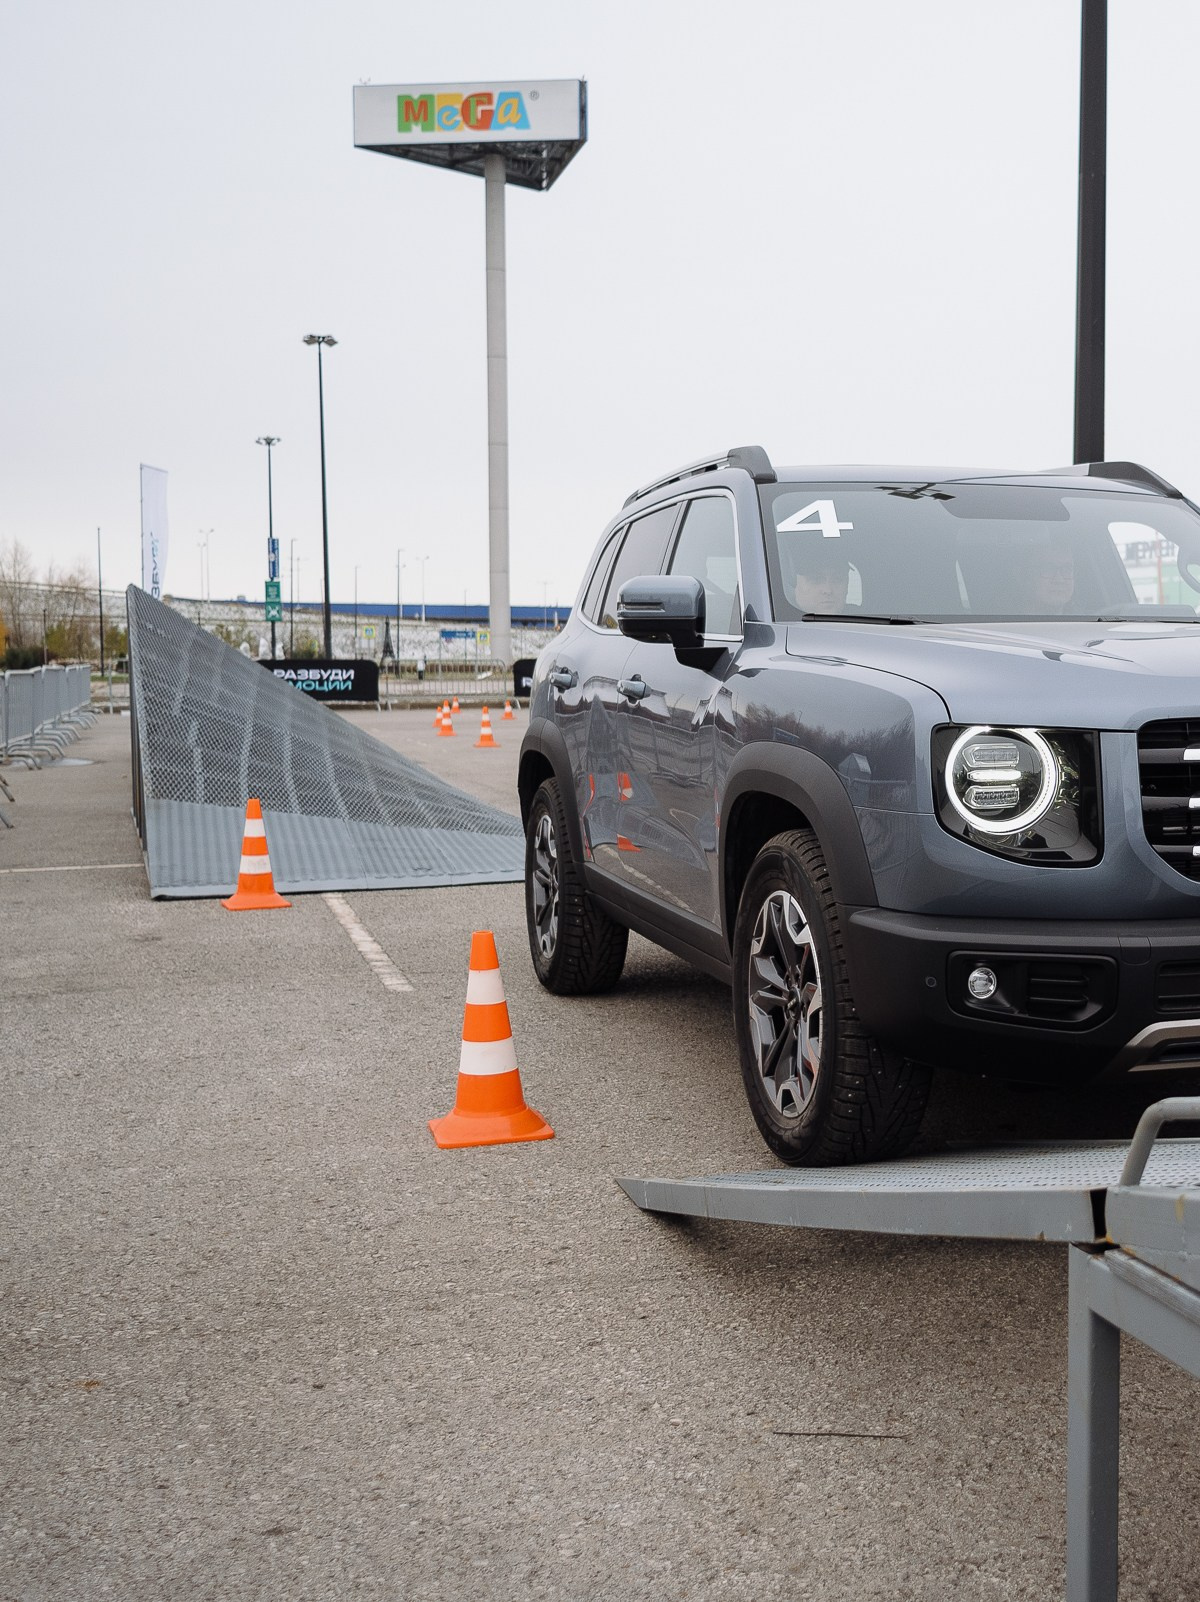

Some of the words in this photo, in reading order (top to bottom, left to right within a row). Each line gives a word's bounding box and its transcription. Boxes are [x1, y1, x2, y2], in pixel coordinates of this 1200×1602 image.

[776, 499, 854, 538] 4
[273, 669, 355, 682] РАЗБУДИ
[288, 680, 353, 692] МОЦИИ
